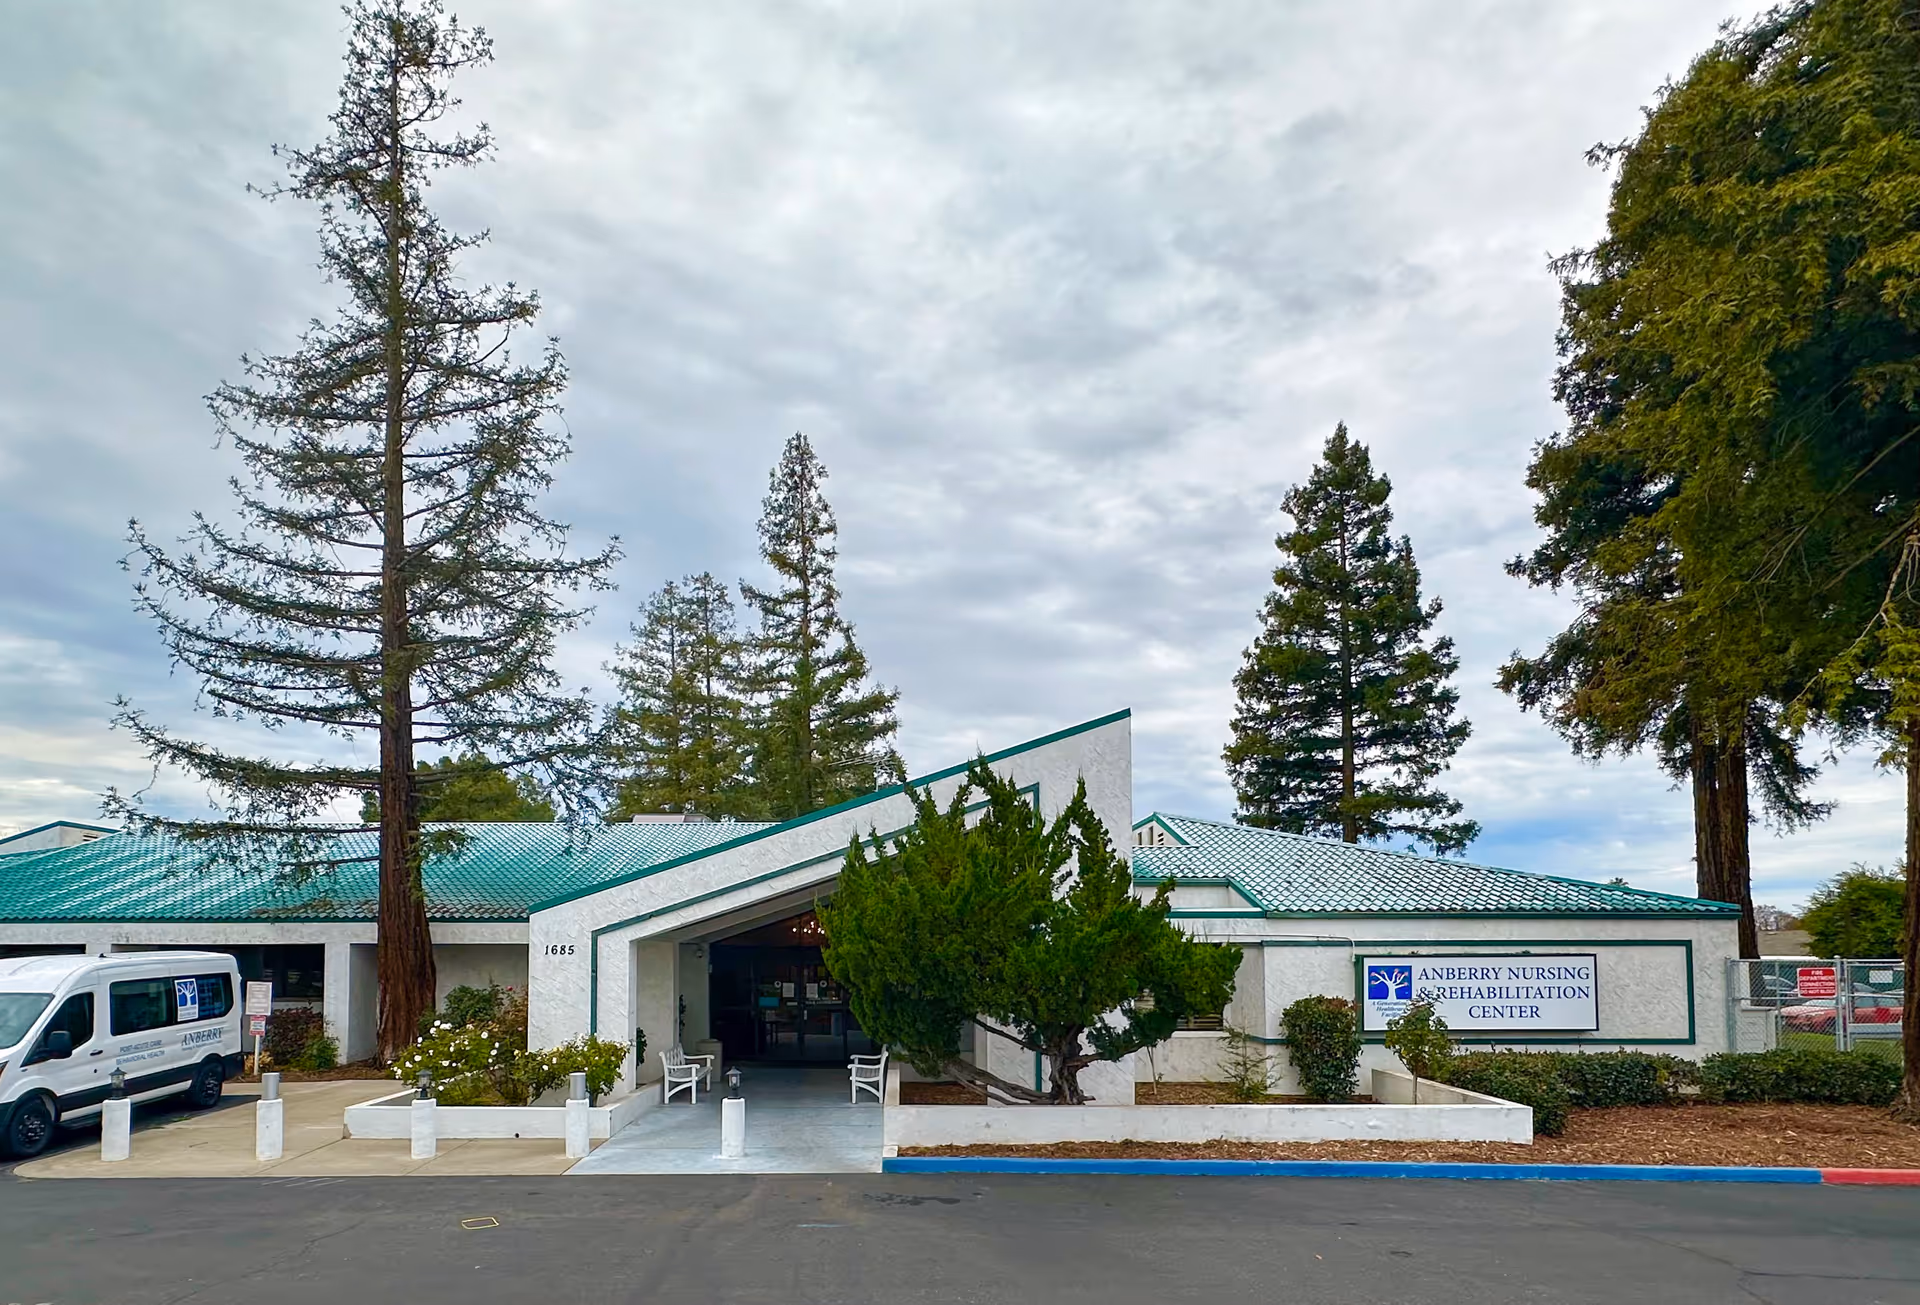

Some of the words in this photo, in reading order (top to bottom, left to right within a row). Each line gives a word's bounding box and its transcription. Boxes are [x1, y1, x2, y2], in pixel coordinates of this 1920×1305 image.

[544, 944, 575, 956] 1685
[1417, 967, 1502, 981] ANBERRY
[1507, 966, 1590, 981] NURSING
[1418, 986, 1433, 999] &
[1437, 986, 1590, 999] REHABILITATION
[1469, 1005, 1541, 1019] CENTER
[181, 1026, 225, 1047] ANBERRY
[147, 1050, 165, 1059] HEALTH
